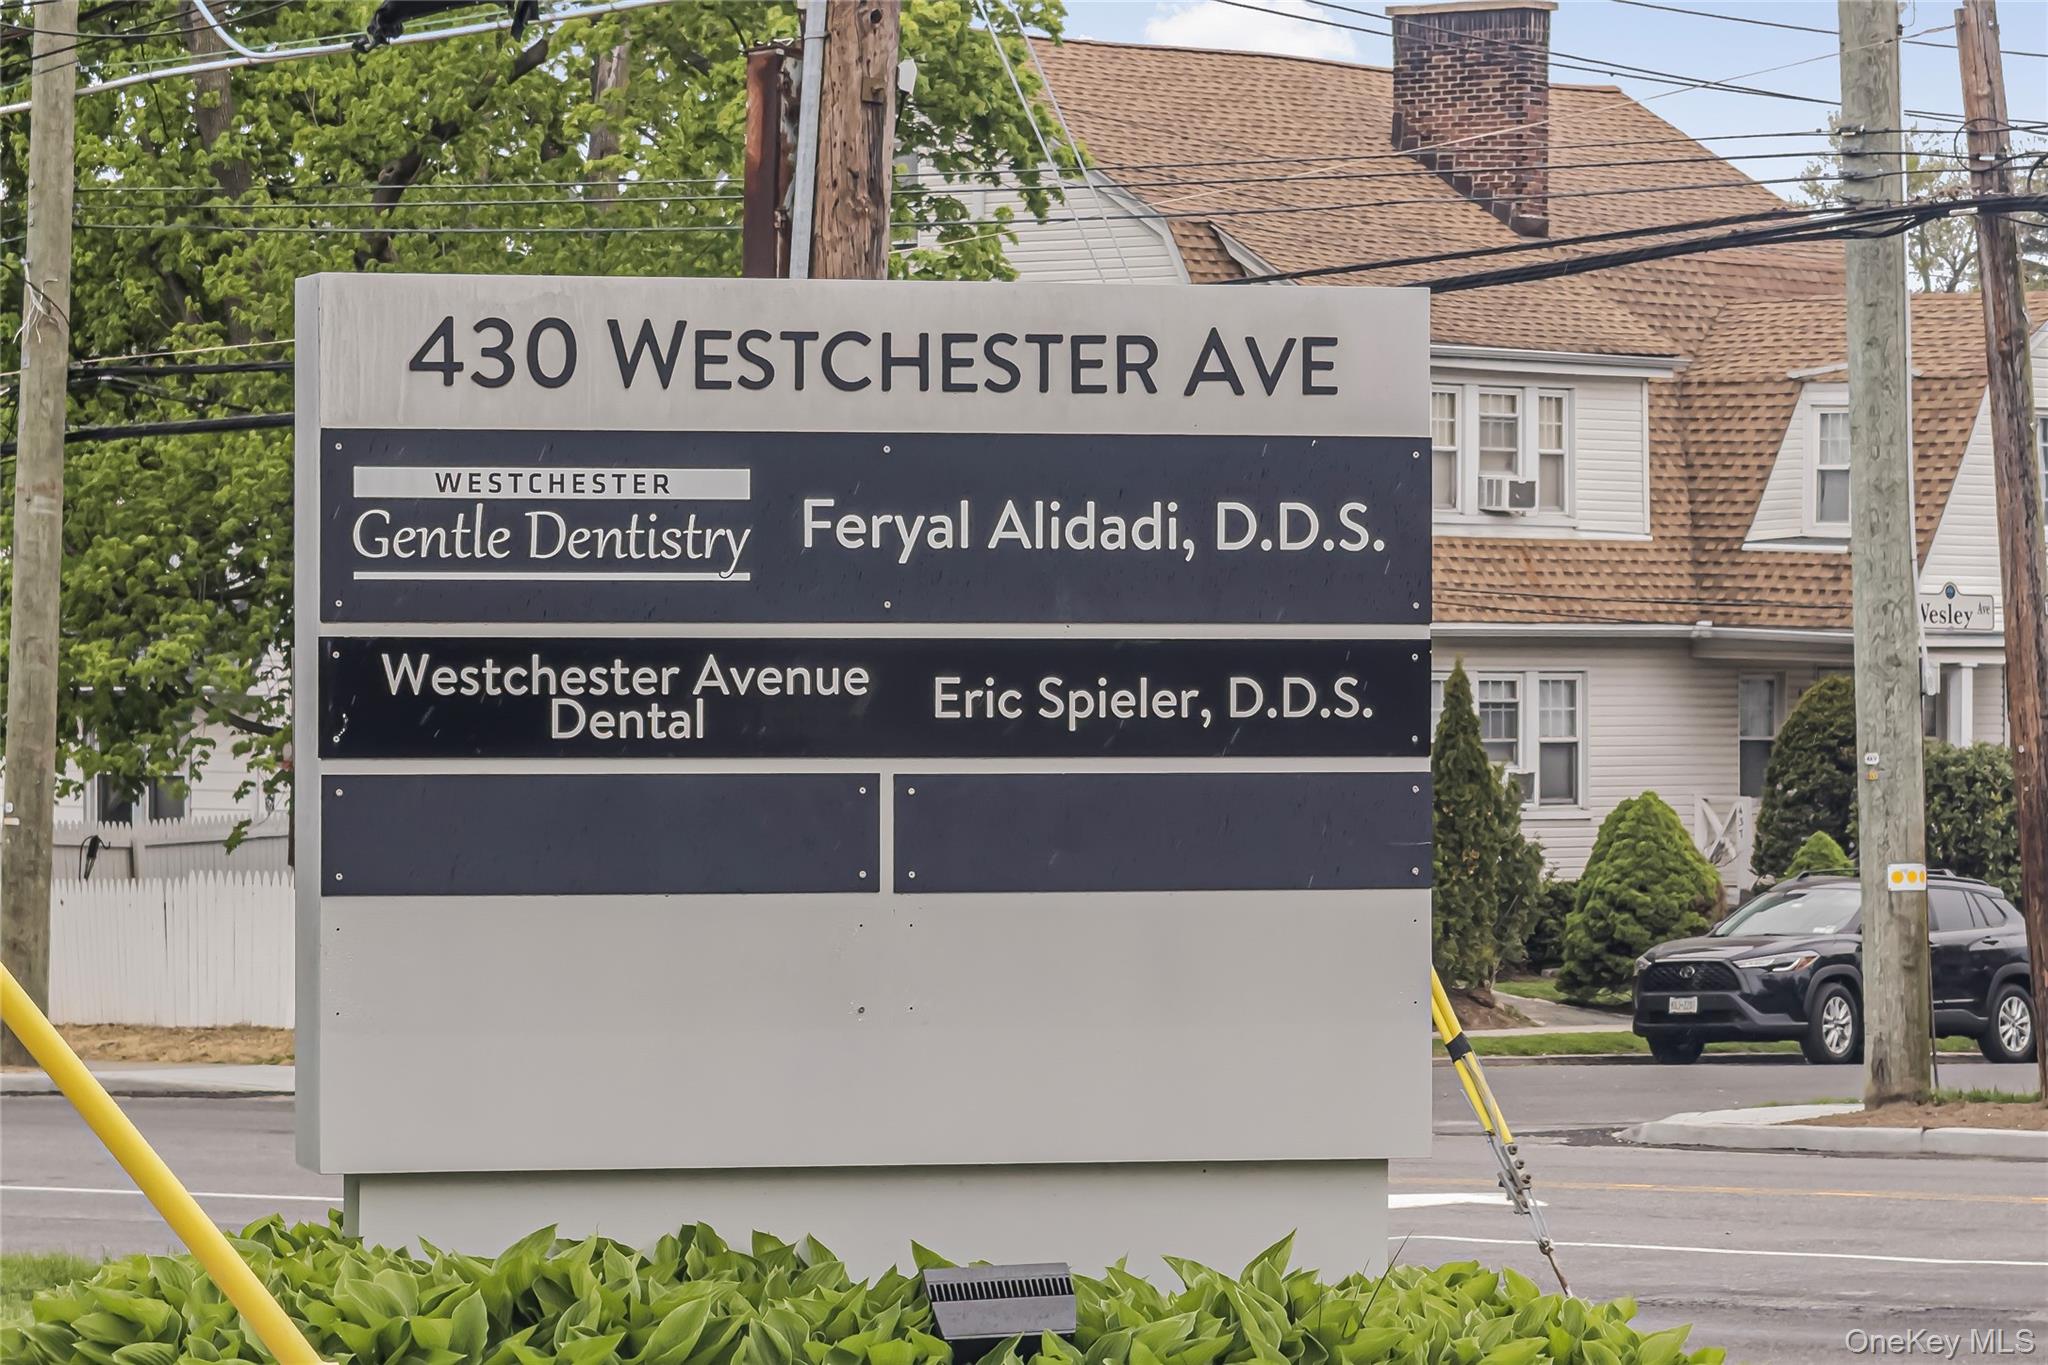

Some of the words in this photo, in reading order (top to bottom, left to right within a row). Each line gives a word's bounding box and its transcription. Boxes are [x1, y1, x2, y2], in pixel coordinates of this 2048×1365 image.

[408, 315, 578, 390] 430
[606, 318, 1159, 395] WESTCHESTER
[1183, 326, 1339, 397] AVE
[435, 472, 671, 494] WESTCHESTER
[352, 502, 511, 560] Gentle
[524, 510, 752, 579] Dentistry
[803, 498, 969, 564] Feryal
[987, 499, 1195, 562] Alidadi,
[1216, 501, 1385, 552] D.D.S.
[1977, 601, 1990, 615] Ave
[381, 653, 681, 697] Westchester
[692, 653, 870, 697] Avenue
[551, 697, 704, 740] Dental
[934, 676, 1023, 719] Eric
[1038, 676, 1212, 732] Spieler,
[1229, 676, 1374, 719] D.D.S.
